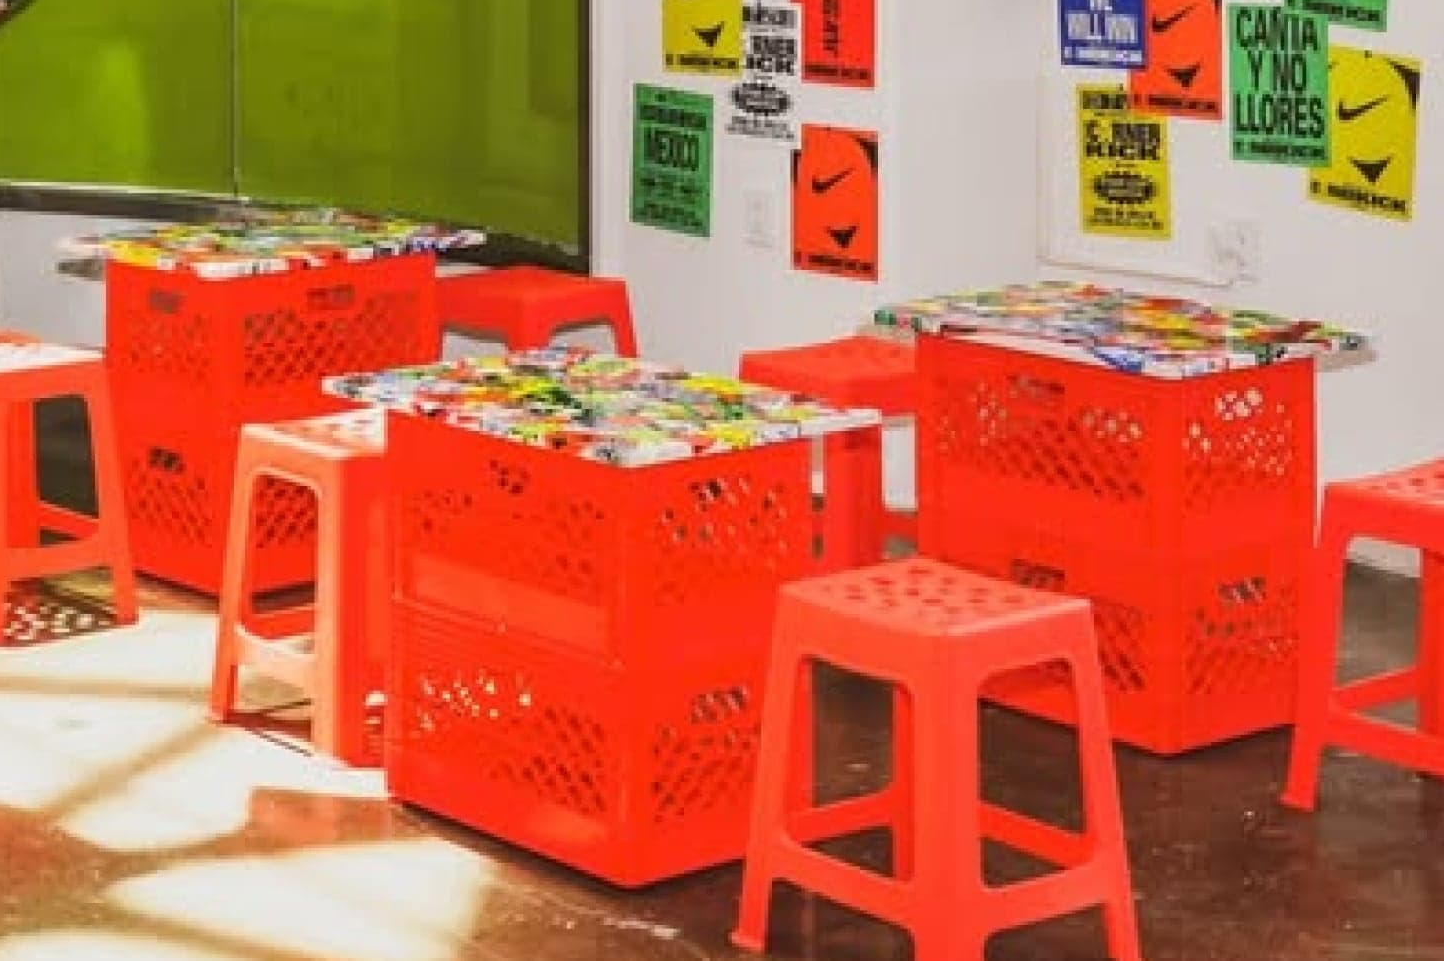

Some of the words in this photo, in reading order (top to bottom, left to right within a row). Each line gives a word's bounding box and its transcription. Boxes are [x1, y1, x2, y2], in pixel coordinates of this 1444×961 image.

[1067, 12, 1103, 41] WILL
[1105, 12, 1138, 44] WIN
[1236, 6, 1318, 52] CANTA
[1248, 52, 1264, 87] Y
[1272, 53, 1307, 91] NO
[1085, 122, 1161, 144] CRNER
[1235, 93, 1322, 140] LLORES
[643, 129, 700, 172] MEXICO
